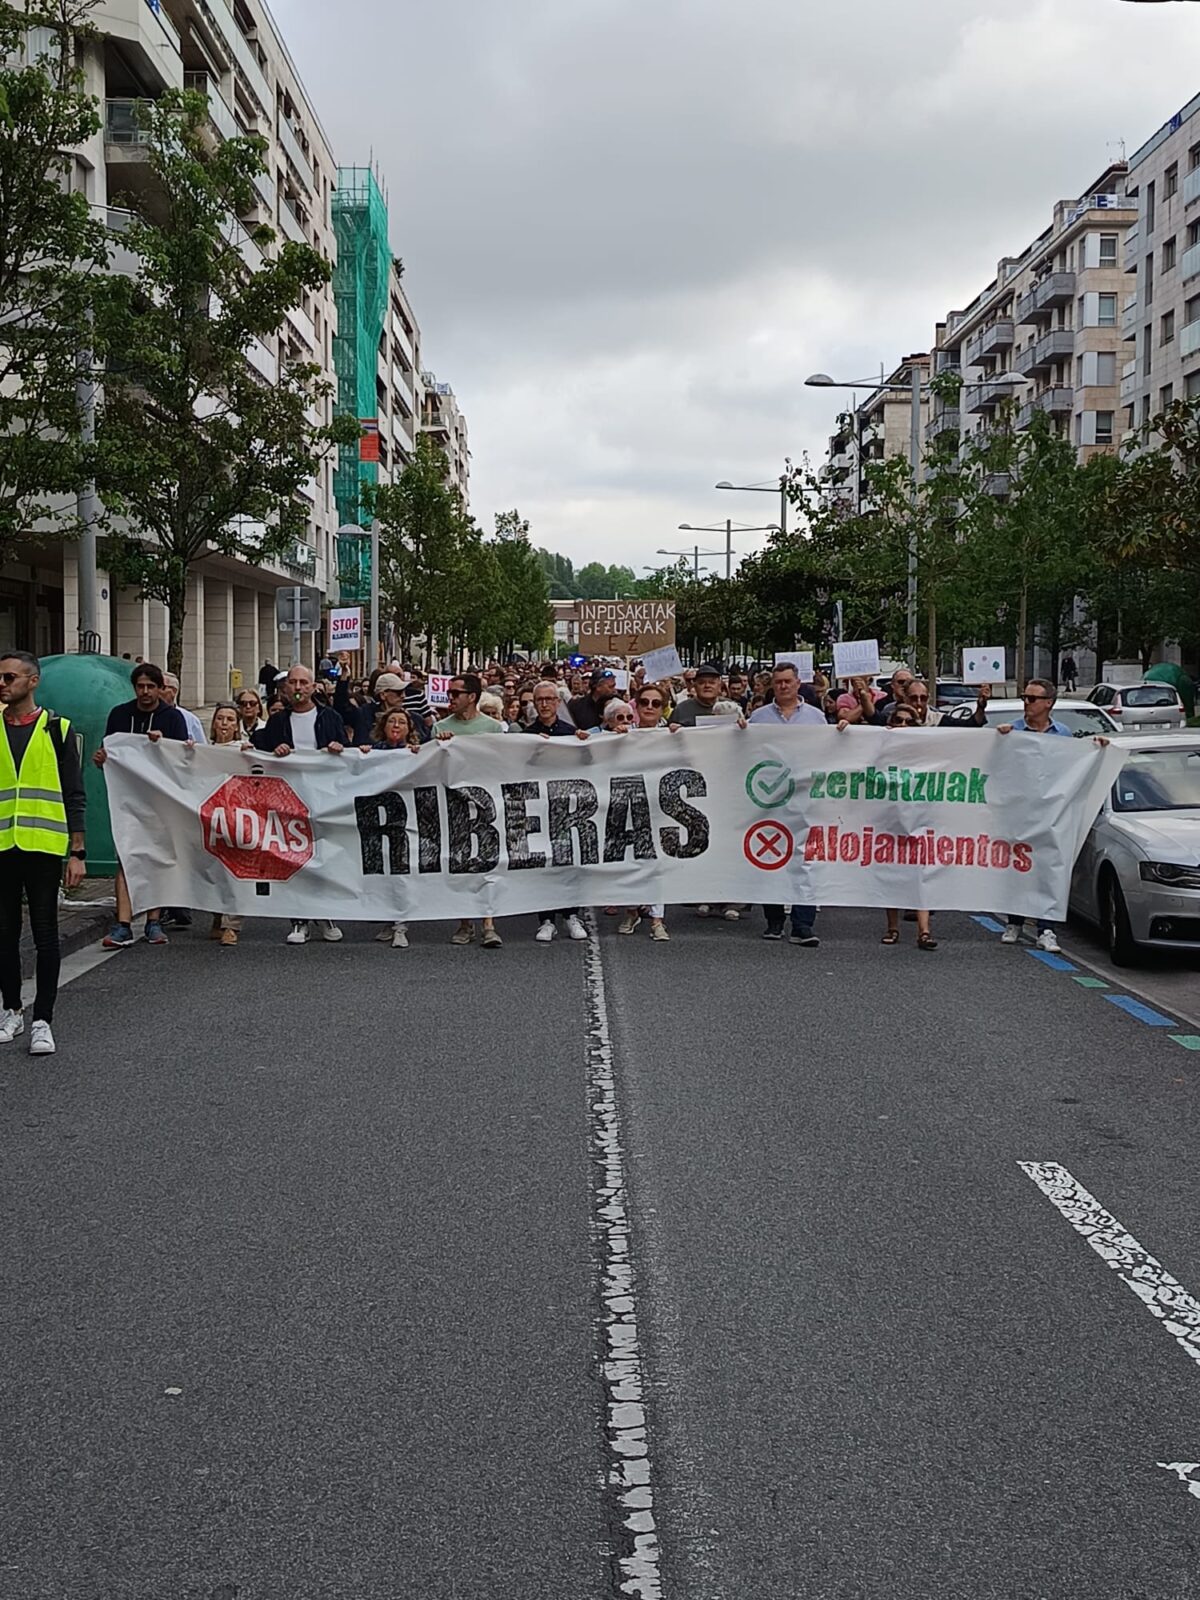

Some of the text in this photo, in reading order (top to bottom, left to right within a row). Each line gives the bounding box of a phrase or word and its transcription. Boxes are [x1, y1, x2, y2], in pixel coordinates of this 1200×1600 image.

[581, 603, 676, 620] INPOSAKETAK
[332, 617, 359, 632] STOP
[581, 620, 667, 635] GEZURRAK
[431, 677, 449, 692] ST
[810, 766, 990, 804] zerbitzuak
[354, 768, 710, 876] RIBERAS
[804, 825, 1034, 873] Alojamientos
